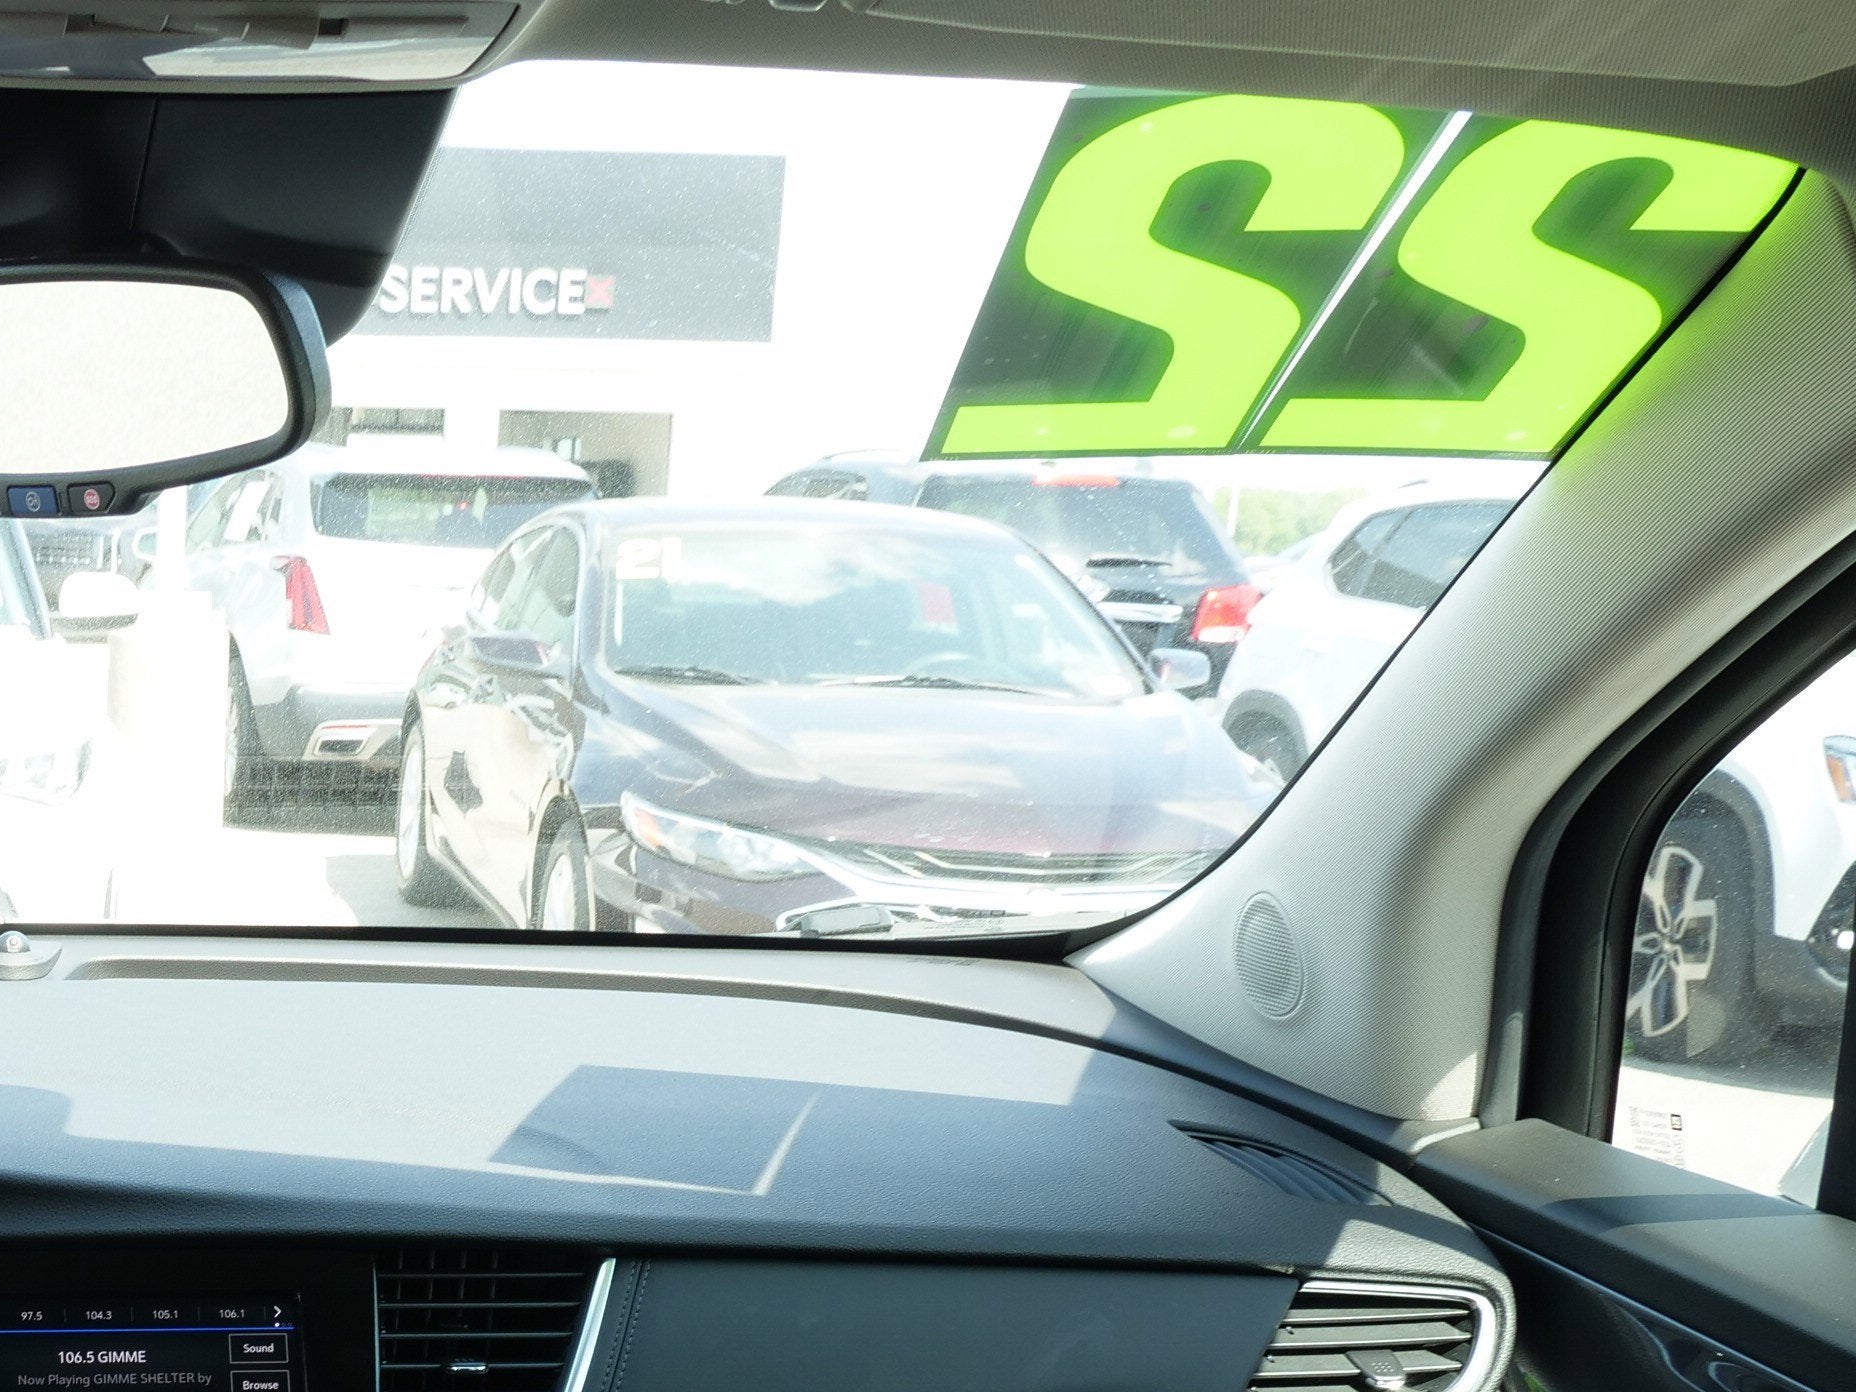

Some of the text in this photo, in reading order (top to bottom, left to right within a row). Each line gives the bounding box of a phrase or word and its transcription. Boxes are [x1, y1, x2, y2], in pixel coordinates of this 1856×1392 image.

[378, 264, 587, 315] SERVICE
[20, 1311, 43, 1321] 97.5
[85, 1310, 113, 1320] 104.3
[152, 1310, 179, 1319] 105.1
[219, 1309, 245, 1319] 106.1
[243, 1343, 275, 1354] Sound
[57, 1350, 147, 1364] 106.5 GIMME
[18, 1371, 212, 1388] Now Playing GIMME SHELTER by
[242, 1380, 280, 1391] Browse
